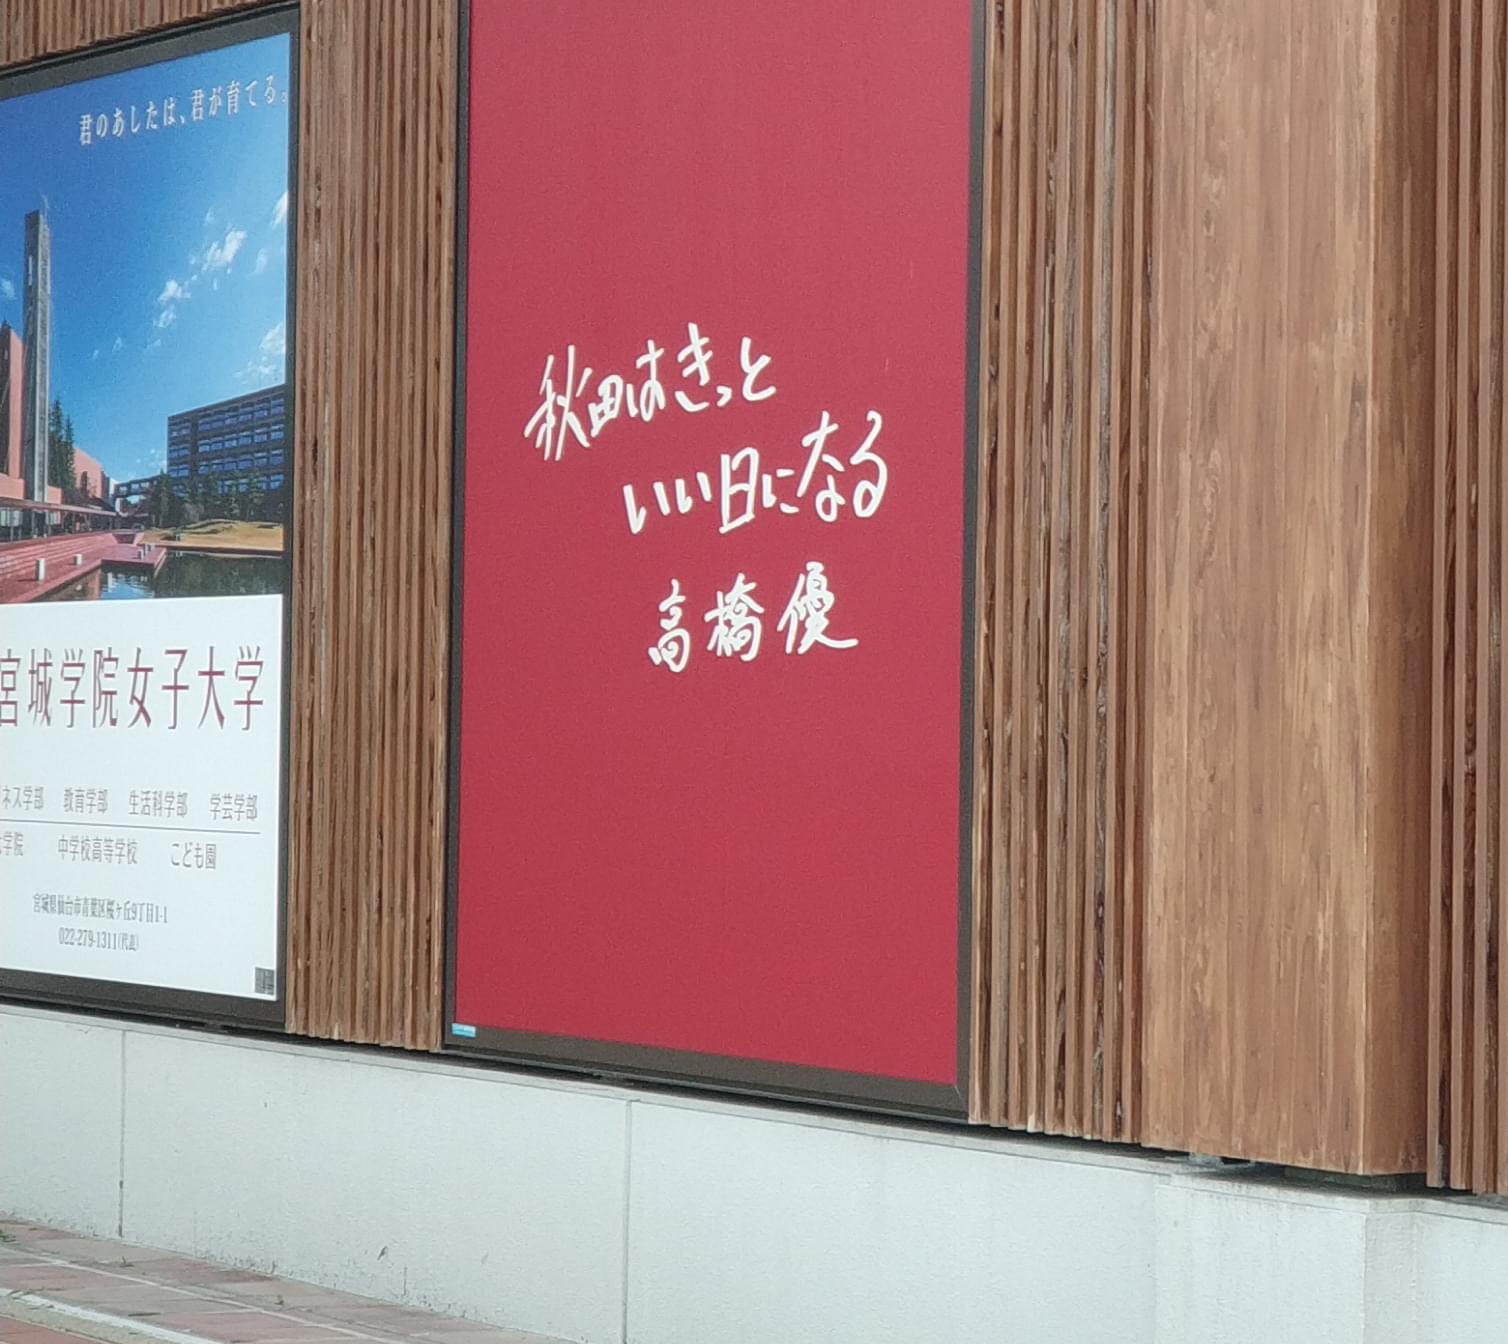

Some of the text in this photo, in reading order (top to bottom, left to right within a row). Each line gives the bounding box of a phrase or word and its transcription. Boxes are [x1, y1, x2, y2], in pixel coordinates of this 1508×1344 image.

[79, 75, 287, 145] 君のあしたは、君が育てる。
[524, 322, 776, 461] 秋田はきっと
[622, 410, 889, 534] いい日になる
[648, 560, 859, 673] 高橋優
[0, 646, 264, 730] 宮城学院女子大学
[64, 787, 108, 814] 教育学部
[128, 789, 188, 818] 生活科学部
[210, 792, 258, 821] 学芸学部
[0, 831, 23, 856] 学院
[171, 842, 216, 869] こども園
